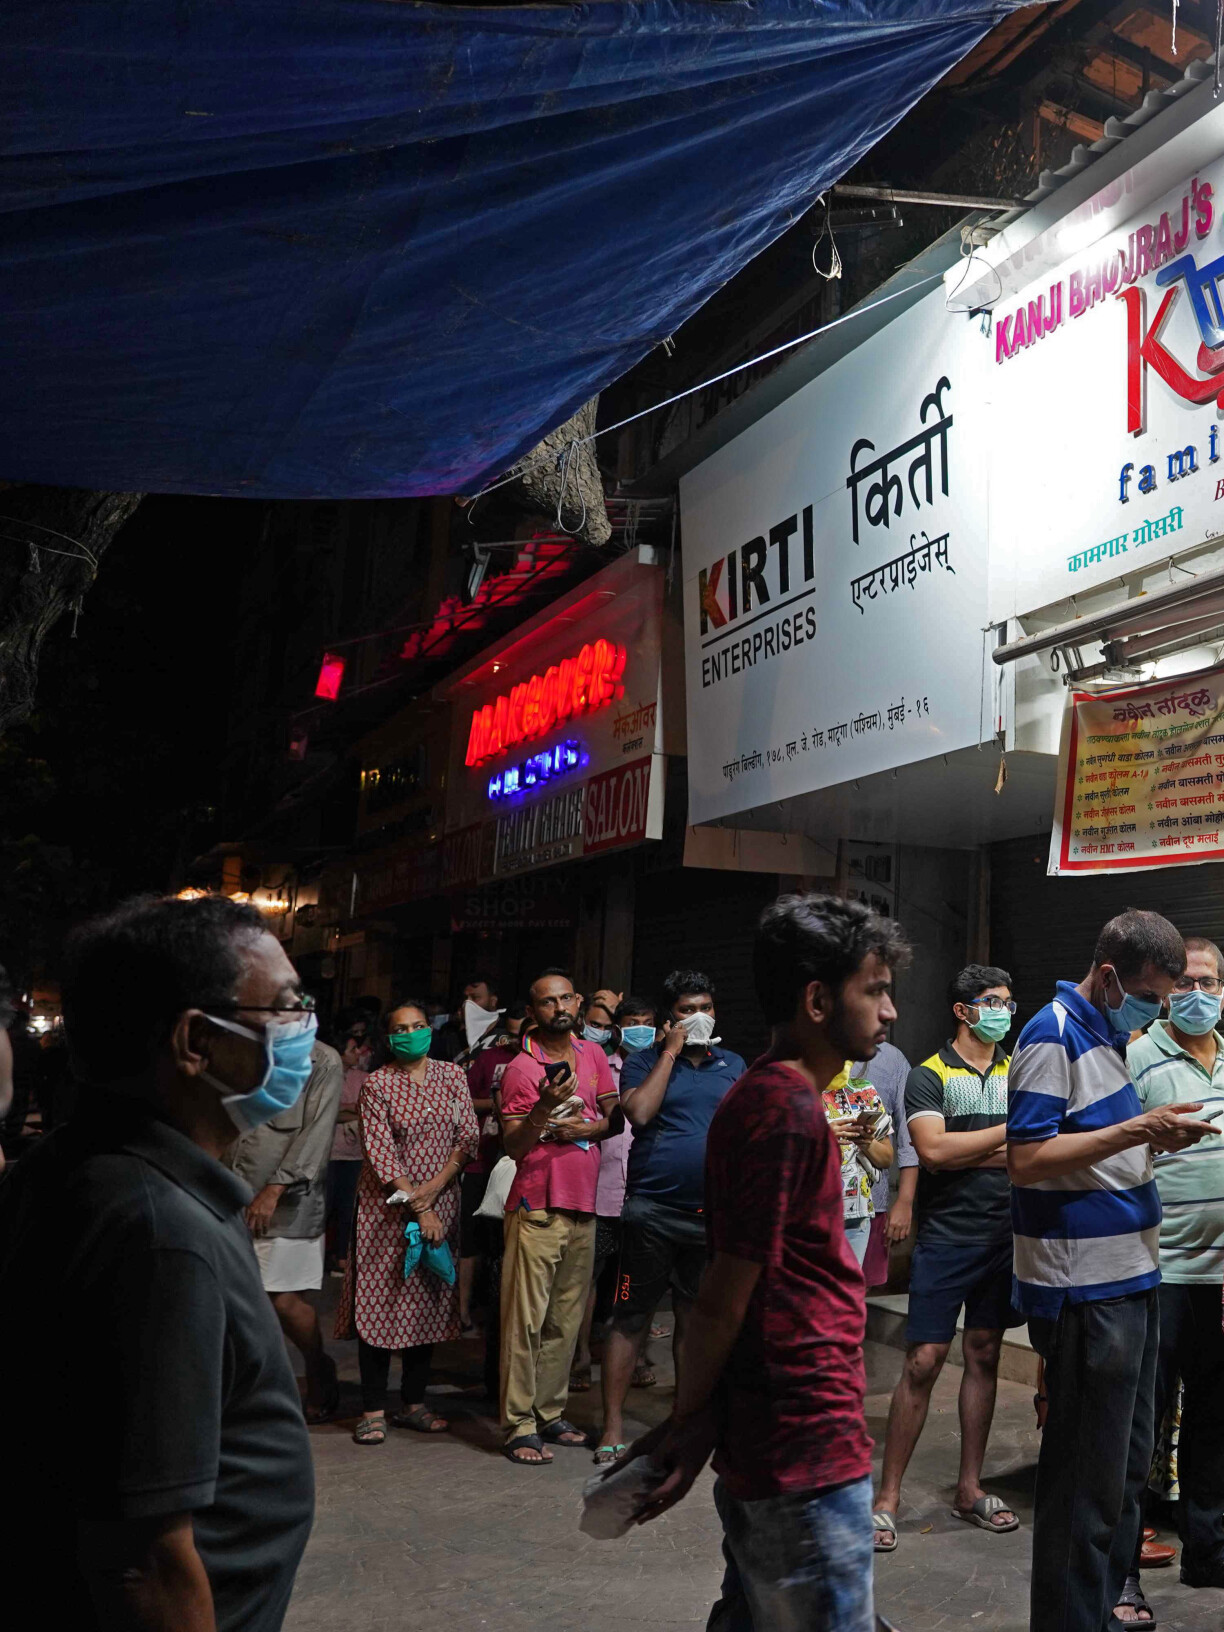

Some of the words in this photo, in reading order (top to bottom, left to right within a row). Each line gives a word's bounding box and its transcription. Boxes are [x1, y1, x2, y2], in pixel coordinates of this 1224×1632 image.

[995, 281, 1063, 365] KANJI
[1067, 531, 1129, 573] कामगार
[1131, 505, 1184, 548] ग्रोसरी
[699, 503, 815, 638] KIRTI
[702, 605, 817, 689] ENTERPRISES
[1112, 702, 1155, 722] नवीन
[1154, 688, 1211, 717] तांदूळ
[766, 748, 785, 766] १७८,
[786, 741, 800, 762] एल.
[801, 731, 810, 751] जे.
[812, 728, 827, 748] रोड,
[887, 697, 905, 730] मुंबई
[916, 696, 930, 719] १६
[1178, 773, 1214, 787] बासमती
[586, 765, 650, 846] SALON
[1083, 807, 1100, 819] नवीन
[1118, 803, 1136, 815] कोलम
[1155, 797, 1178, 810] नवीन
[1179, 791, 1215, 807] बासमती
[1082, 825, 1099, 837] नवीन
[1157, 816, 1179, 828] नवीन
[1181, 813, 1203, 827] आंबा
[1081, 843, 1098, 855] नवीन
[1117, 841, 1135, 852] कोलम
[1159, 835, 1180, 847] नवीन
[1182, 835, 1195, 848] दूध
[1197, 829, 1219, 844] मलाई
